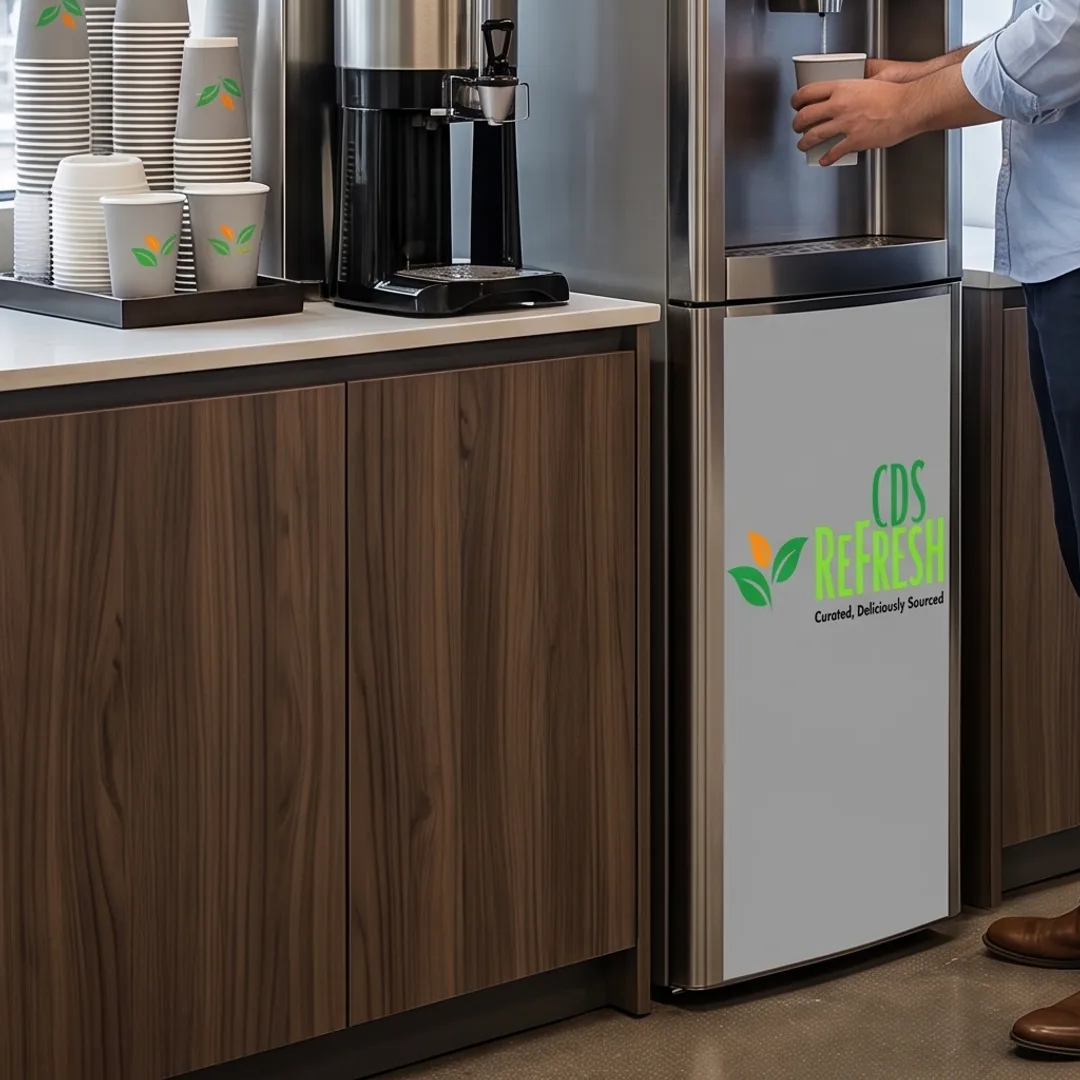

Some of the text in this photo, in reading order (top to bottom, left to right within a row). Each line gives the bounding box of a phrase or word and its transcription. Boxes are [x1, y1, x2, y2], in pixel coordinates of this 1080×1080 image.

[872, 459, 926, 528] CDS
[814, 590, 944, 623] Curated, Deliciously Sourced
